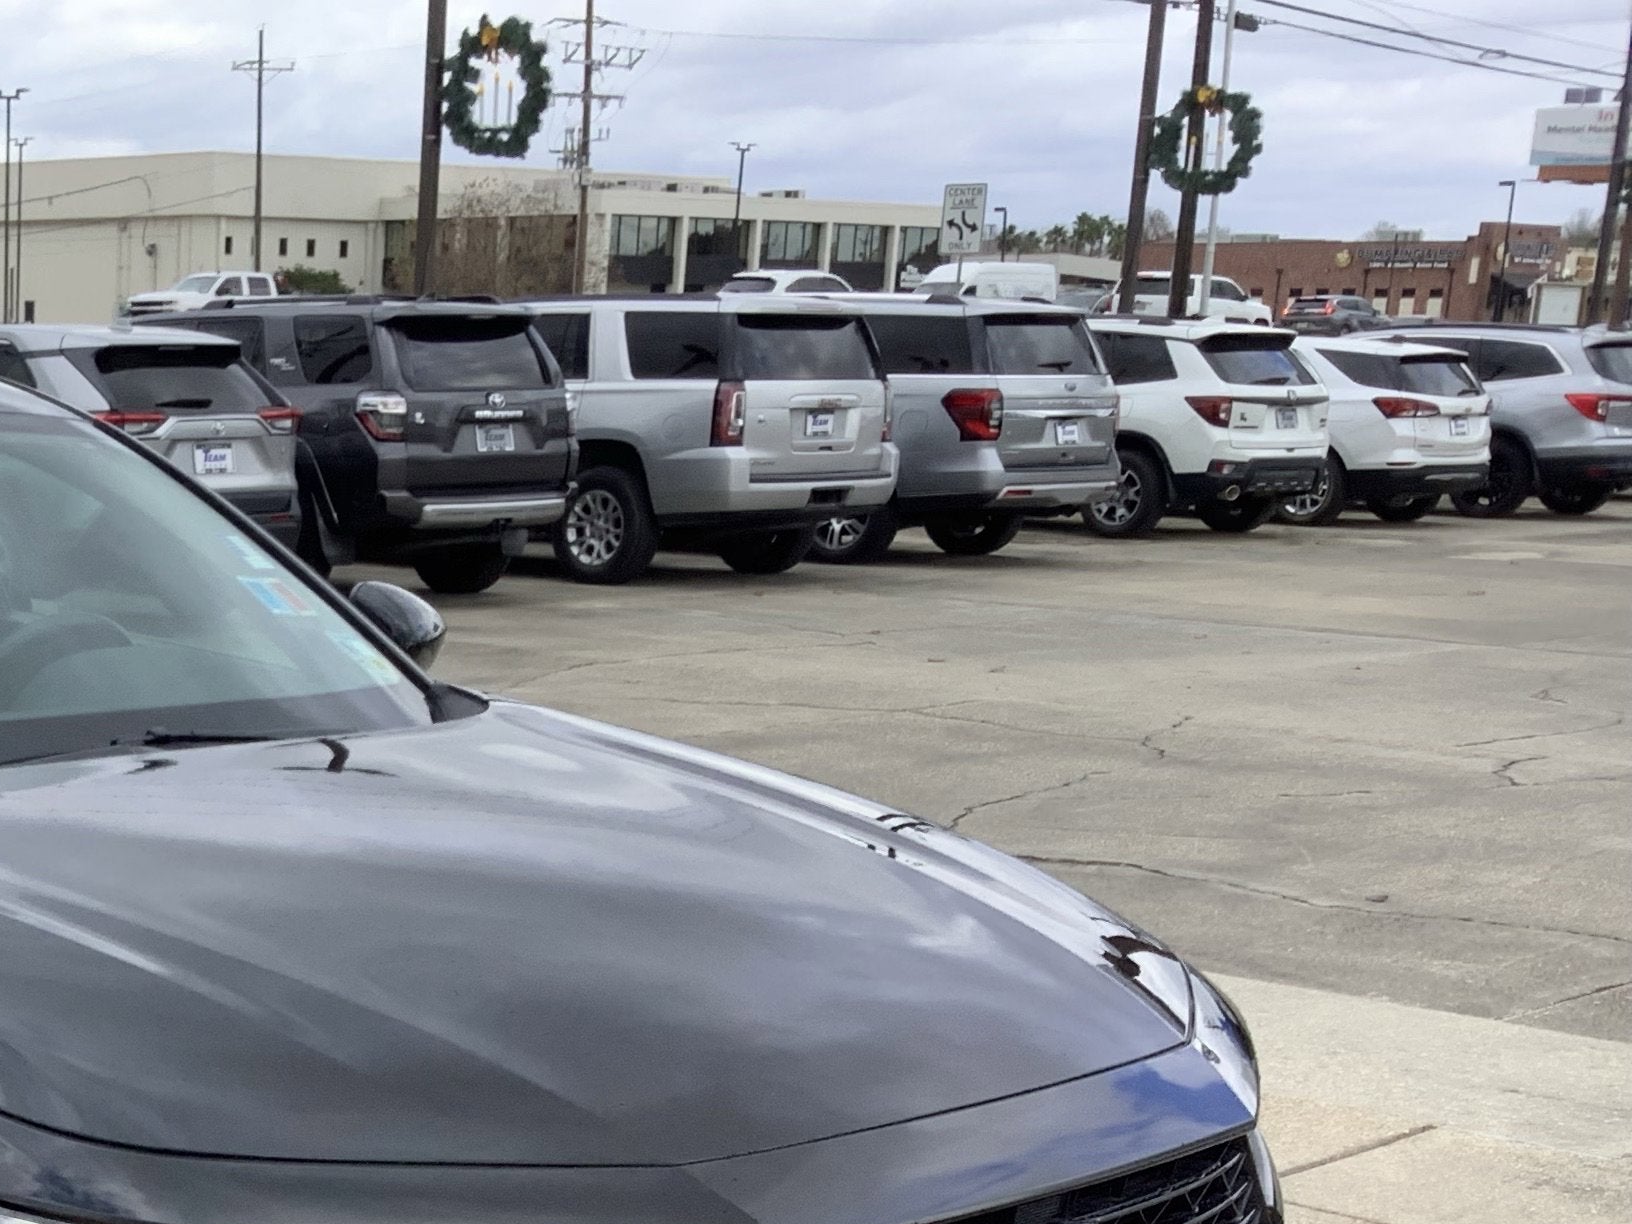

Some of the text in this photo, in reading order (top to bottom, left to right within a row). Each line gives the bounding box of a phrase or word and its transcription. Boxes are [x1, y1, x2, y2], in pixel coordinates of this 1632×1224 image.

[948, 187, 984, 197] CENTER
[952, 198, 976, 206] LANE
[948, 241, 973, 252] ONLY
[202, 447, 227, 463] TEAM
